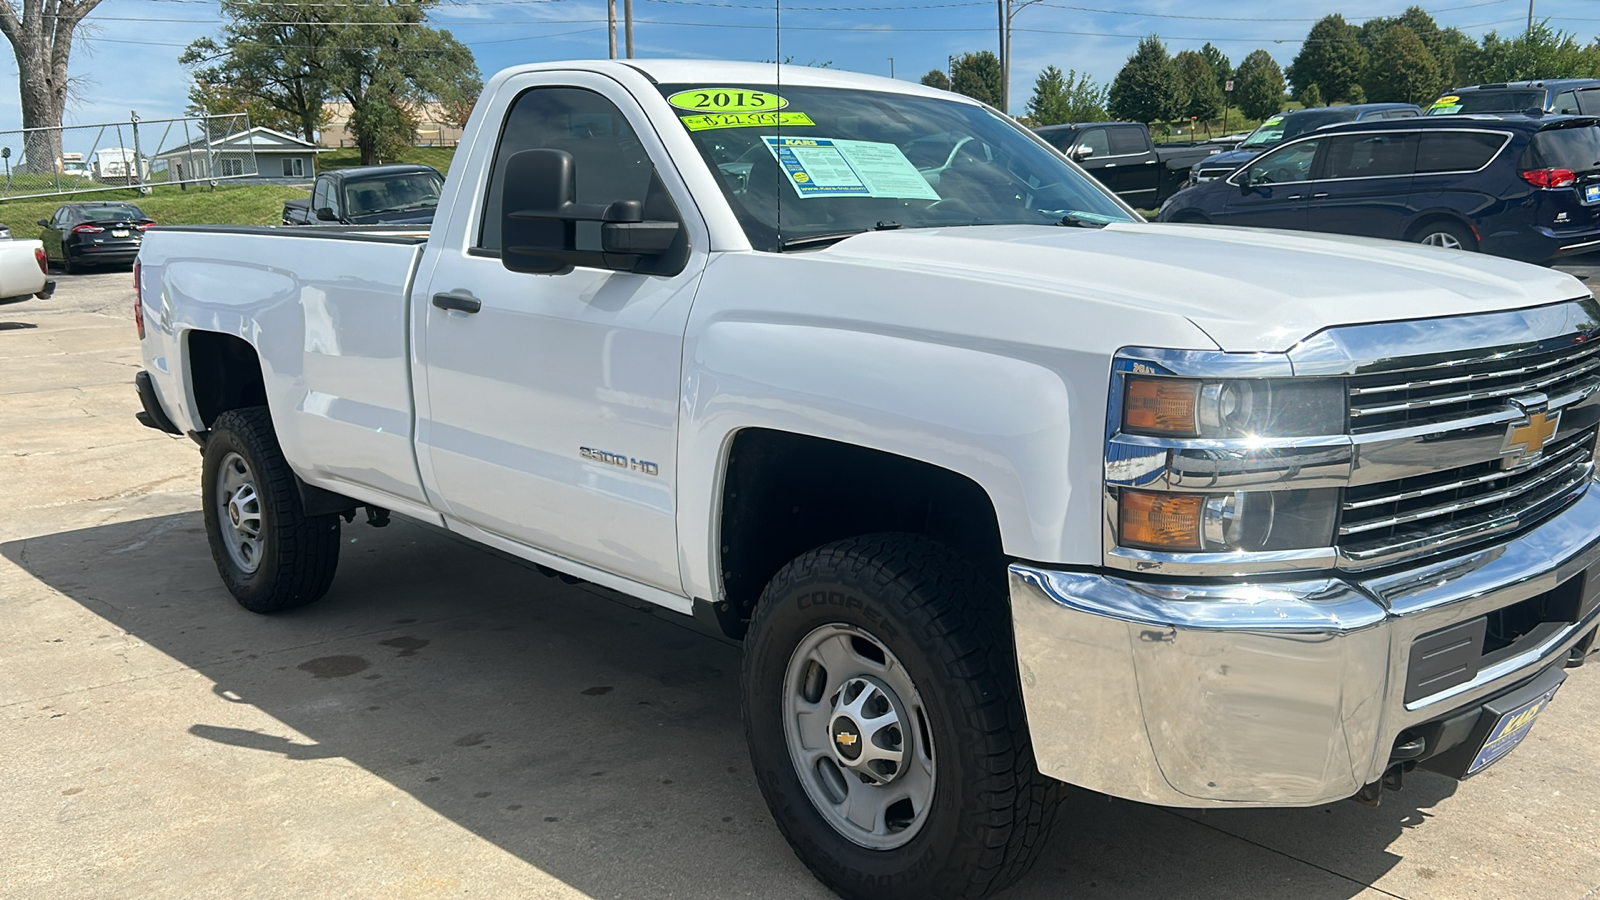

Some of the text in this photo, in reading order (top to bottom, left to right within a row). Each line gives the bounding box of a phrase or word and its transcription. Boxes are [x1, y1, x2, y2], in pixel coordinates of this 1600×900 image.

[694, 93, 766, 107] 2015
[579, 446, 659, 476] 2500 HD
[797, 591, 900, 639] COOPER
